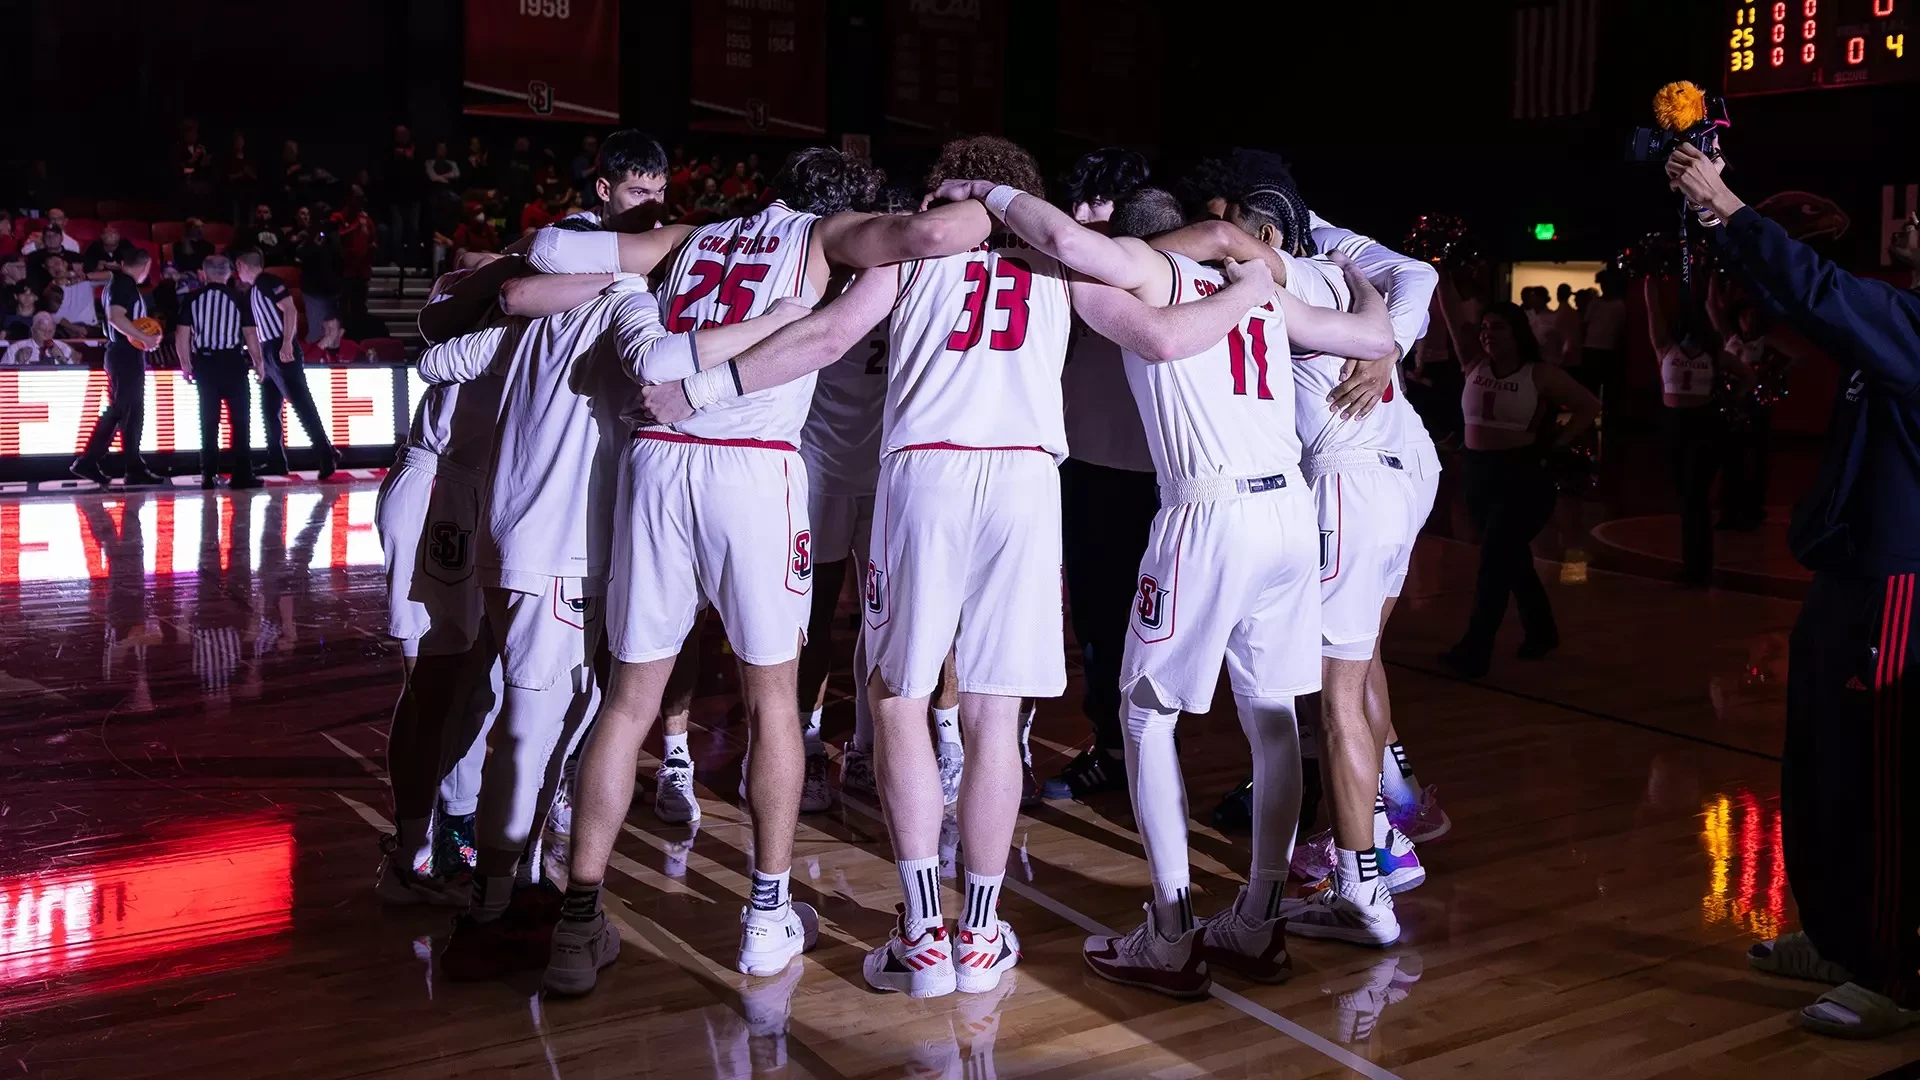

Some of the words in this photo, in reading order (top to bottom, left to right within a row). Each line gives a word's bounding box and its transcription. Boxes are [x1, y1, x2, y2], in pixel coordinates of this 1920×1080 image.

[1736, 7, 1756, 25] 11
[1772, 2, 1786, 21] 0
[1729, 27, 1755, 49] 25
[1772, 23, 1785, 43] 0
[1803, 19, 1816, 39] 0
[1847, 36, 1865, 65] 0
[1886, 34, 1904, 58] 4
[1730, 50, 1755, 72] 33
[1771, 46, 1784, 67] 0
[1802, 43, 1815, 63] 0
[667, 259, 771, 333] 25
[946, 257, 1032, 352] 33
[1227, 317, 1274, 401] 11
